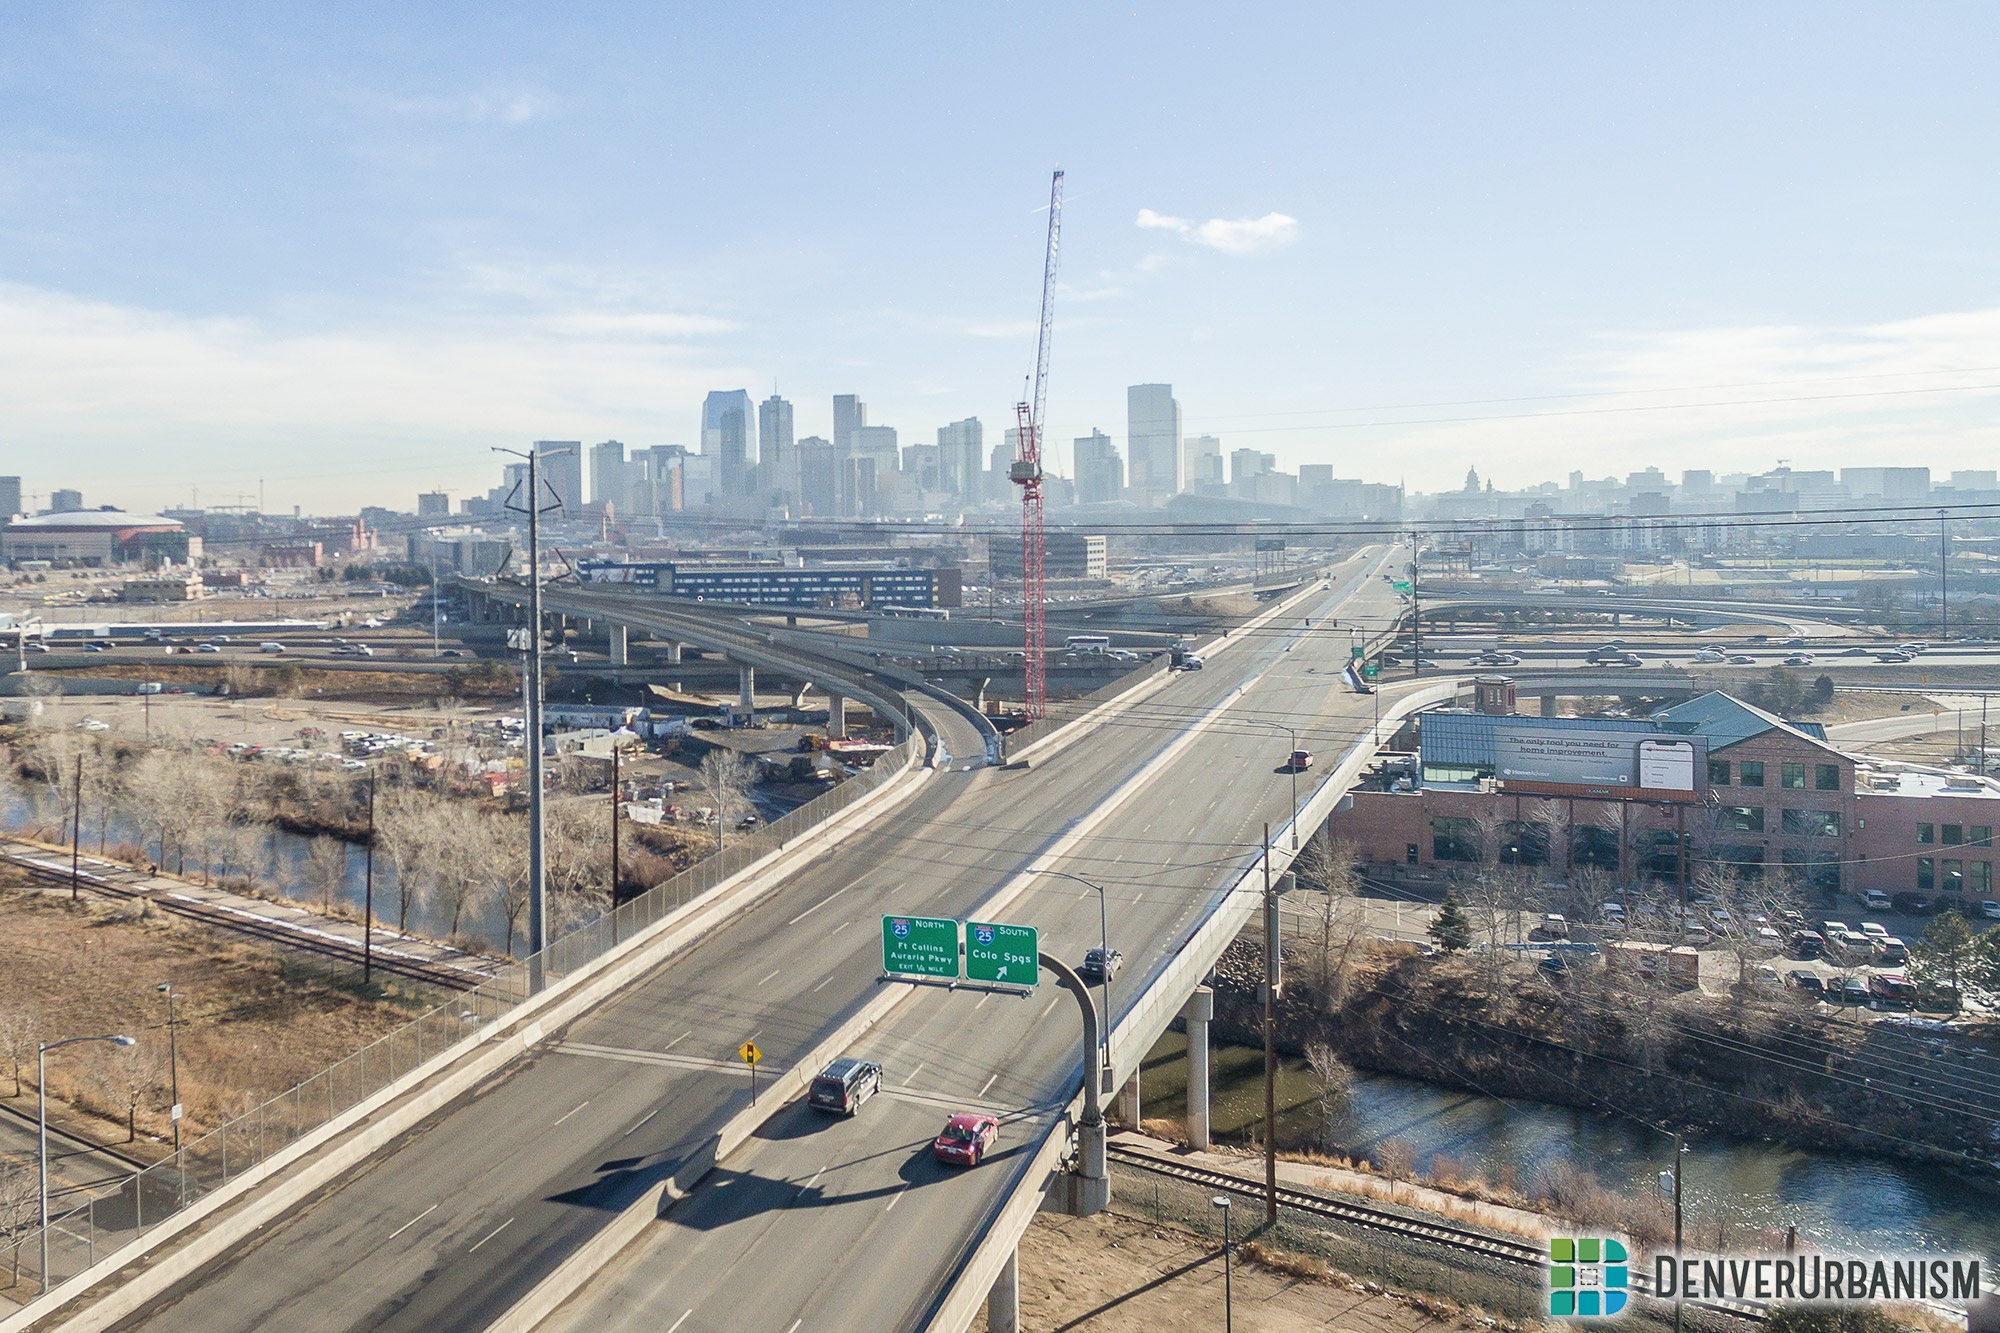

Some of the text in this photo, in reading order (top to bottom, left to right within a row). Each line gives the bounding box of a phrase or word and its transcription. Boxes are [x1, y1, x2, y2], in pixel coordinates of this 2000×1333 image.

[1526, 738, 1545, 746] only
[1520, 746, 1608, 757] home improvement.
[894, 924, 908, 935] 25
[915, 919, 945, 930] NORTH
[978, 931, 992, 942] 25
[999, 926, 1029, 937] SOUTH
[898, 941, 944, 952] Ft Collins
[890, 951, 952, 965] Auraria Pkwy
[972, 948, 1031, 965] Colo Spgs
